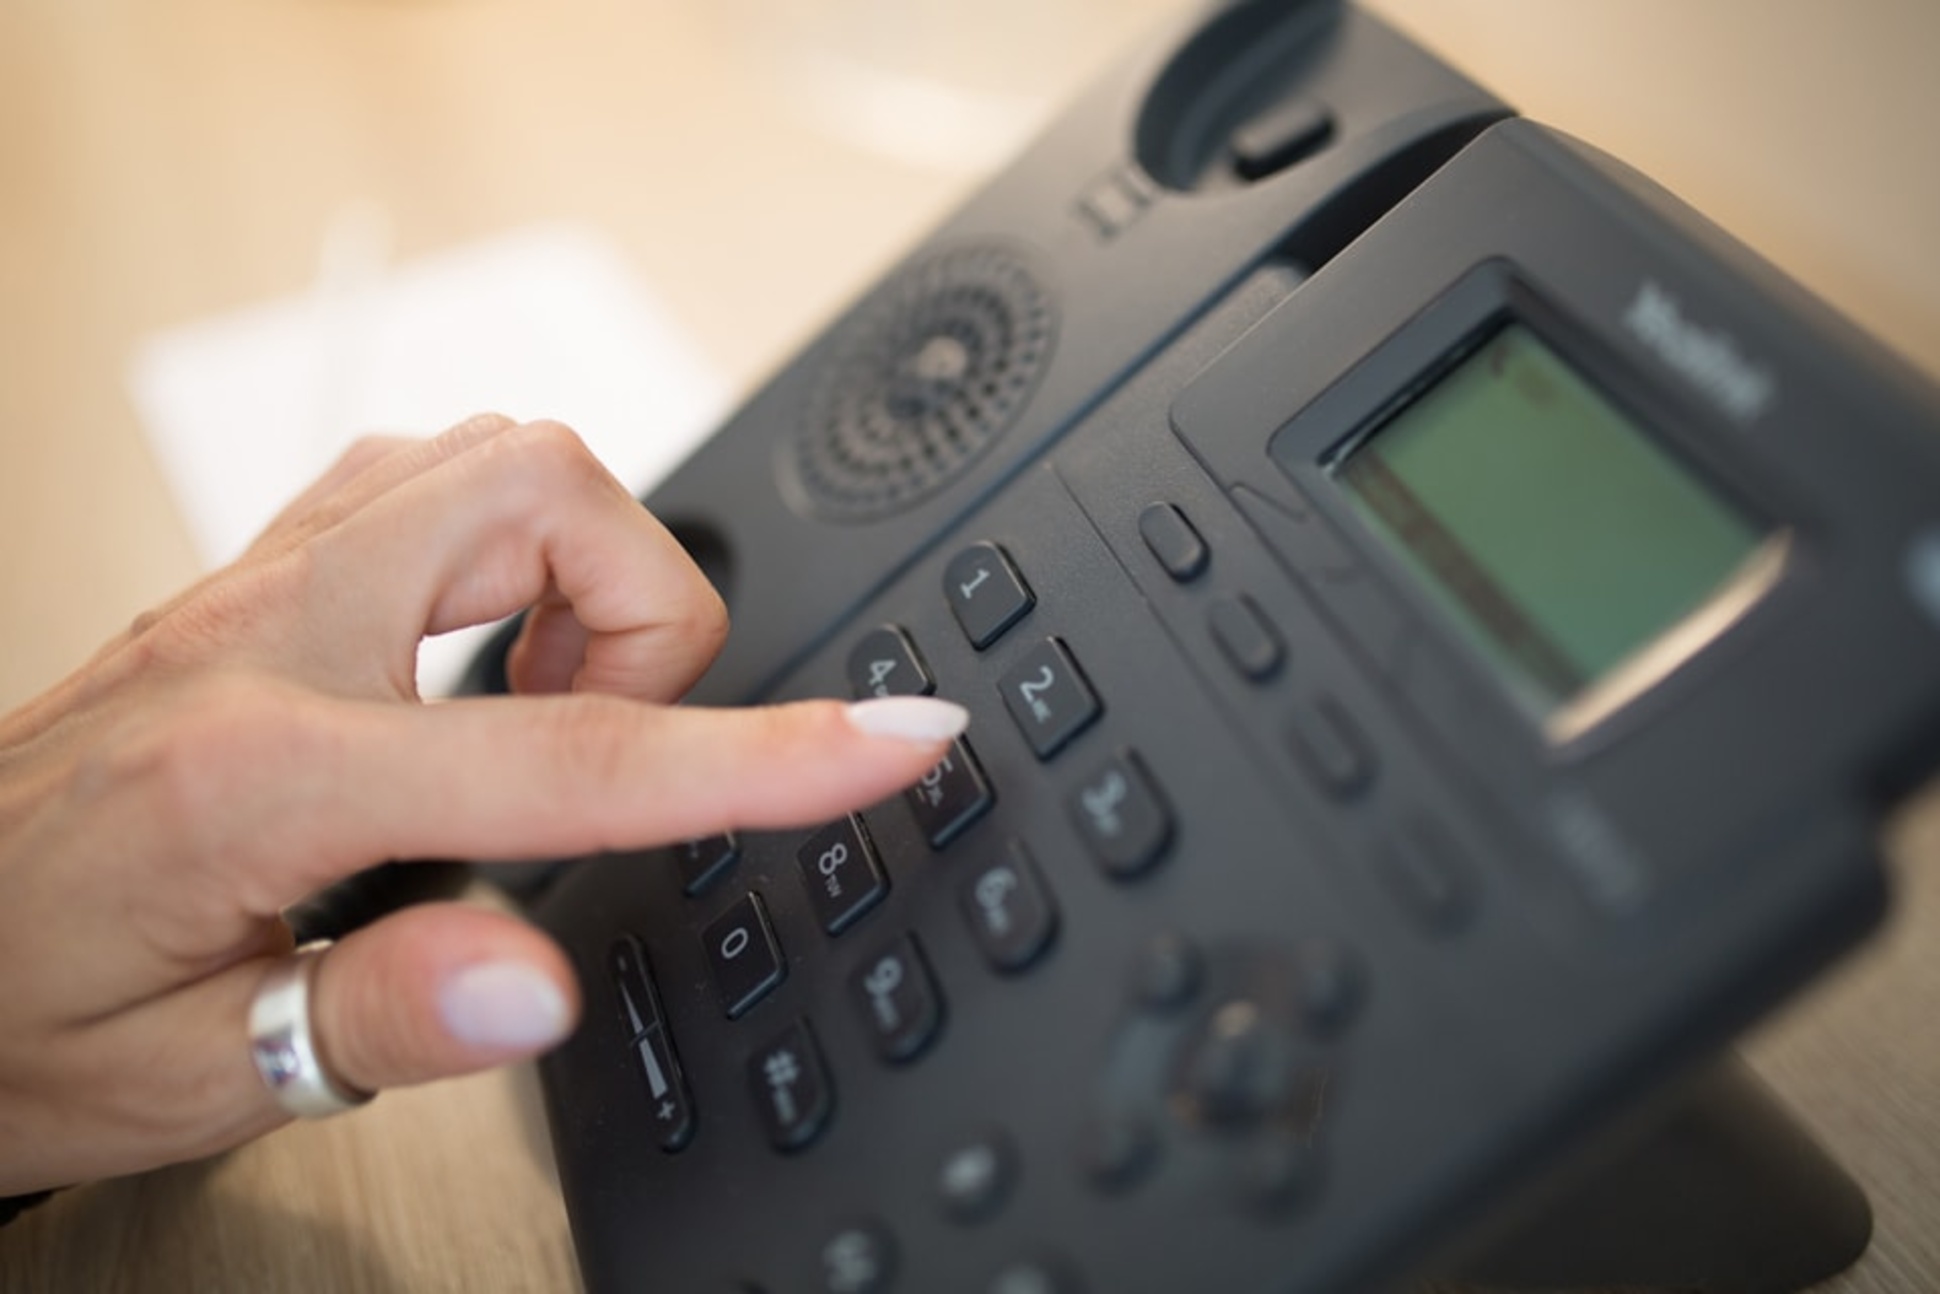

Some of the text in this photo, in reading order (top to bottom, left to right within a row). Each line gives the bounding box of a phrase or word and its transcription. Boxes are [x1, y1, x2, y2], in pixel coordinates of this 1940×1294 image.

[961, 569, 990, 599] 1
[869, 660, 896, 686] 4
[1020, 665, 1053, 702] 2
[1082, 771, 1126, 816] 3
[819, 843, 847, 875] 8
[976, 867, 1017, 909] 6
[721, 927, 749, 959] 0
[864, 957, 902, 995] 9
